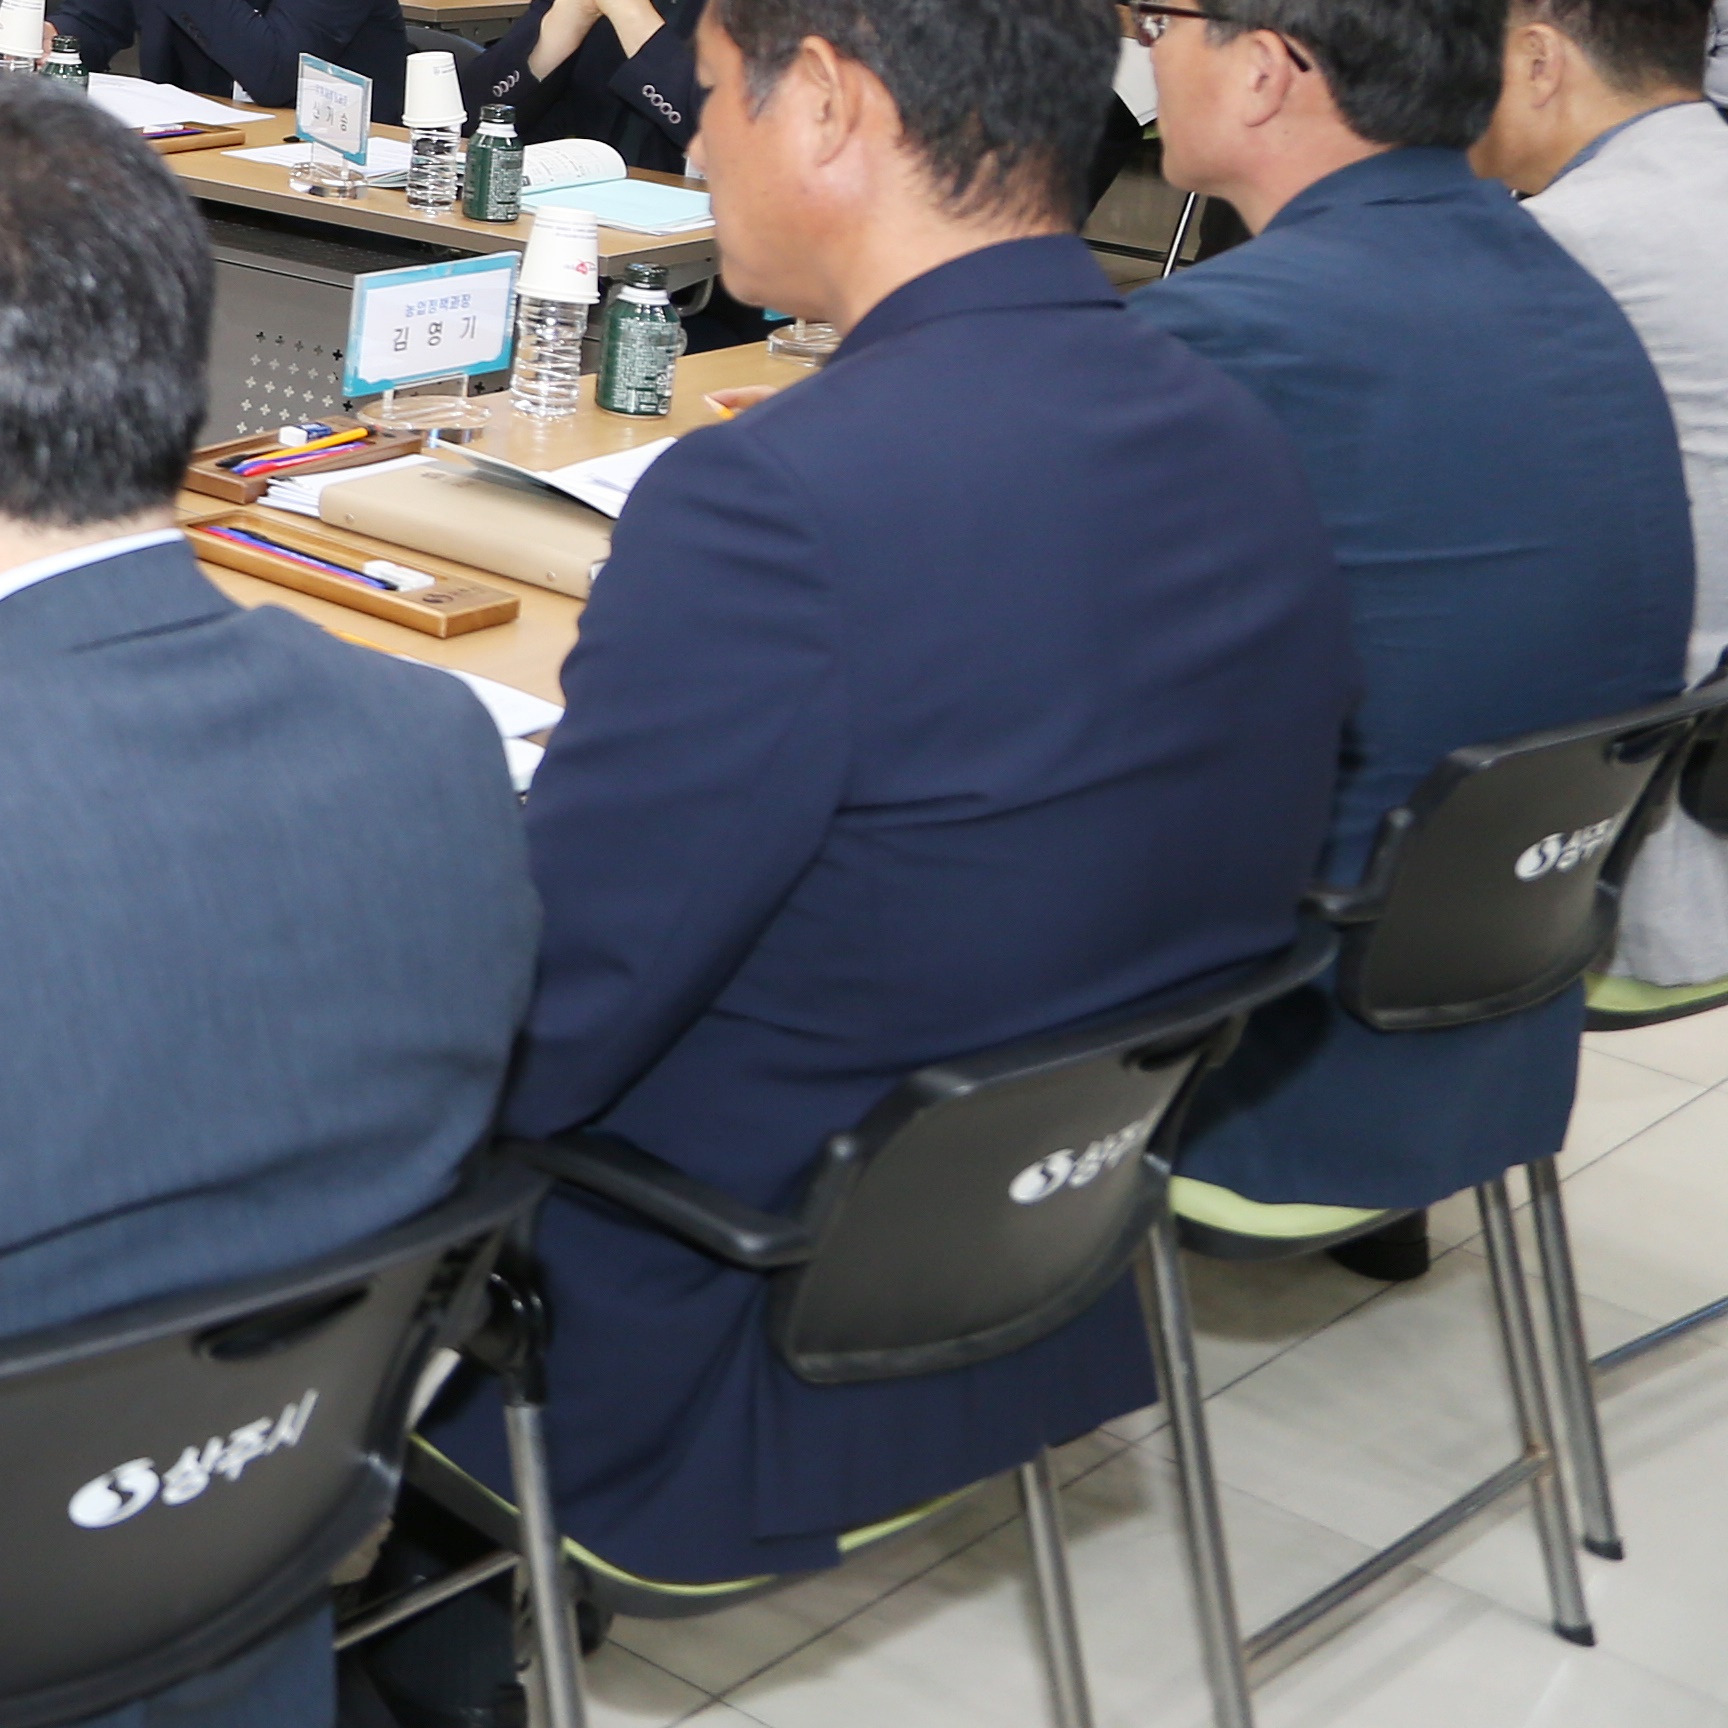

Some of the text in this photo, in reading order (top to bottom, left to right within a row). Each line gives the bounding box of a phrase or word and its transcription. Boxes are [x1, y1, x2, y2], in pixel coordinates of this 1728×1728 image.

[405, 293, 472, 318] 농업정책과장
[1555, 817, 1618, 872] 상주
[1068, 1119, 1150, 1189] 상주
[160, 1387, 321, 1507] 상주시
